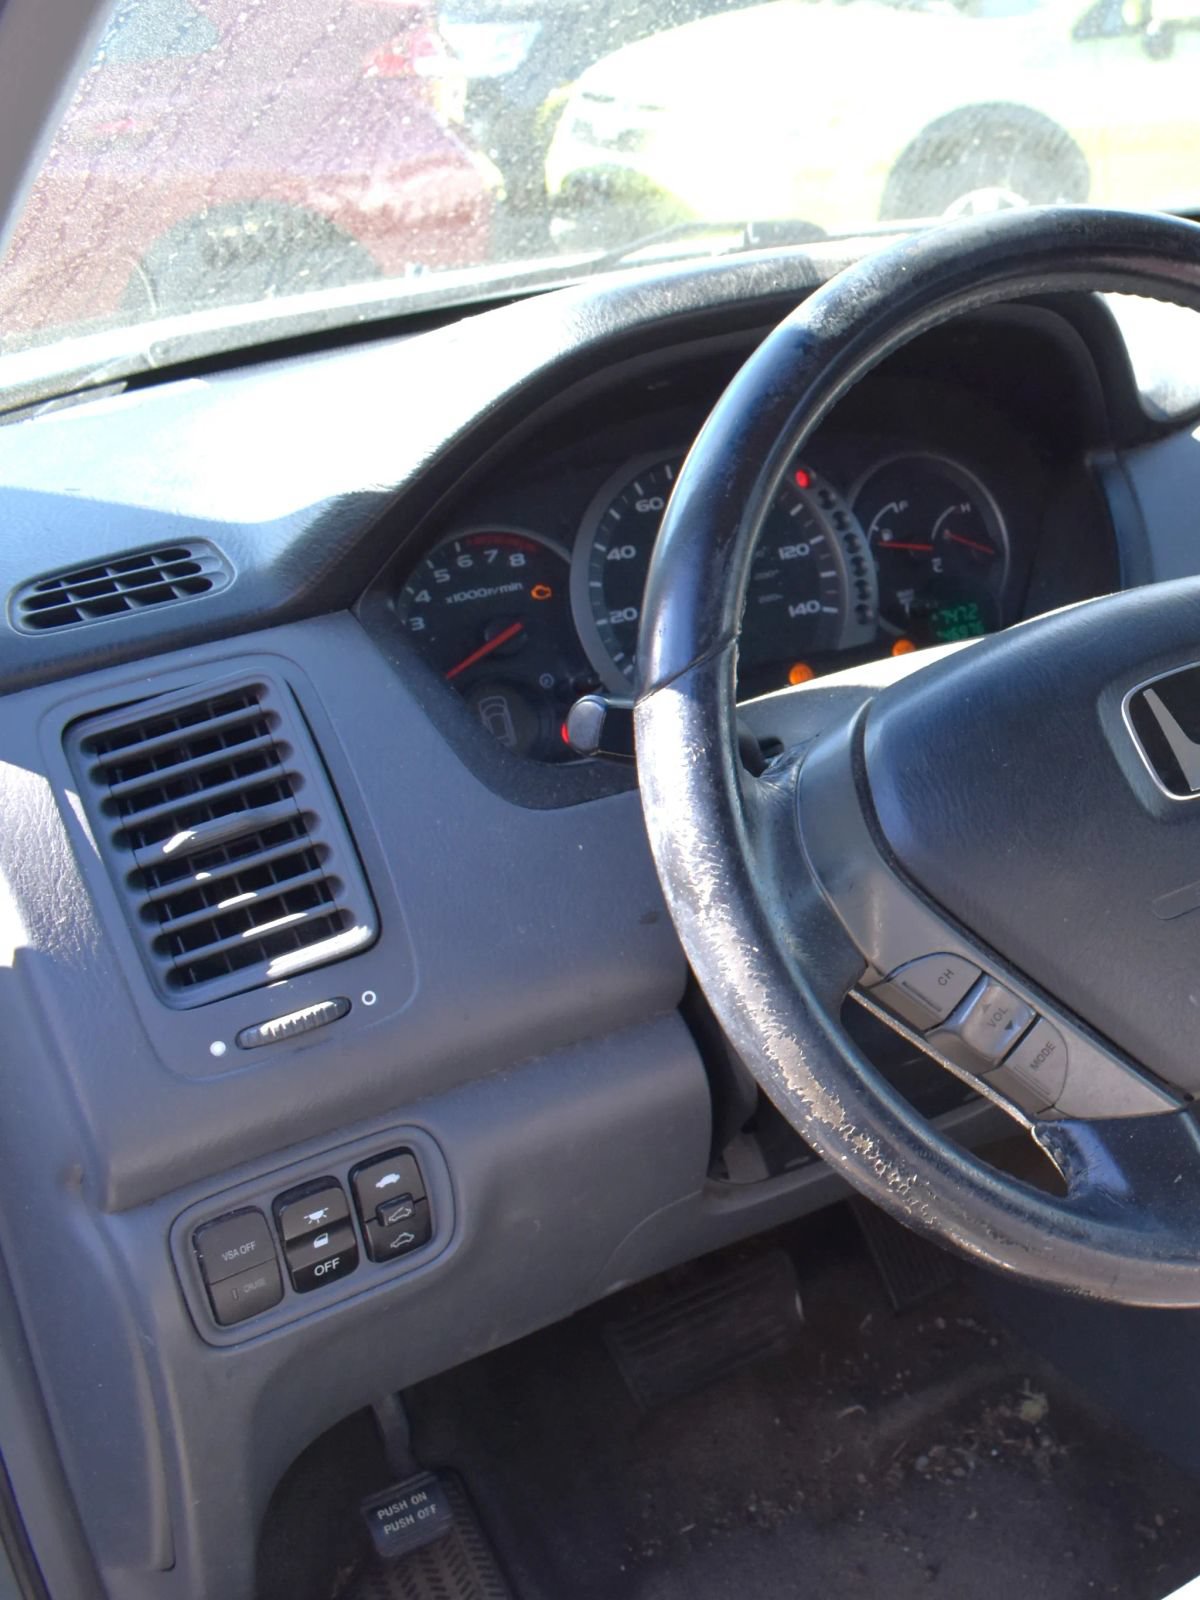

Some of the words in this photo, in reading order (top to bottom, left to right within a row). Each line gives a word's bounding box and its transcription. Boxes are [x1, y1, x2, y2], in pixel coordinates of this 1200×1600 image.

[635, 496, 665, 513] 60
[483, 548, 499, 564] 7
[509, 552, 526, 568] 8
[606, 545, 637, 560] 40
[778, 543, 810, 560] 120
[456, 554, 474, 568] 6
[433, 568, 451, 583] 5
[414, 589, 432, 603] 4
[609, 607, 638, 624] 20
[788, 600, 821, 618] 140
[409, 616, 426, 632] 3
[937, 968, 955, 986] CH
[987, 1007, 1009, 1028] VOL
[1029, 1041, 1056, 1071] MODE
[239, 1240, 256, 1255] OFF
[313, 1256, 341, 1277] OFF
[376, 1500, 409, 1520] PUSH
[410, 1491, 428, 1505] ON
[383, 1514, 416, 1535] PUSH
[416, 1503, 438, 1520] OFF
